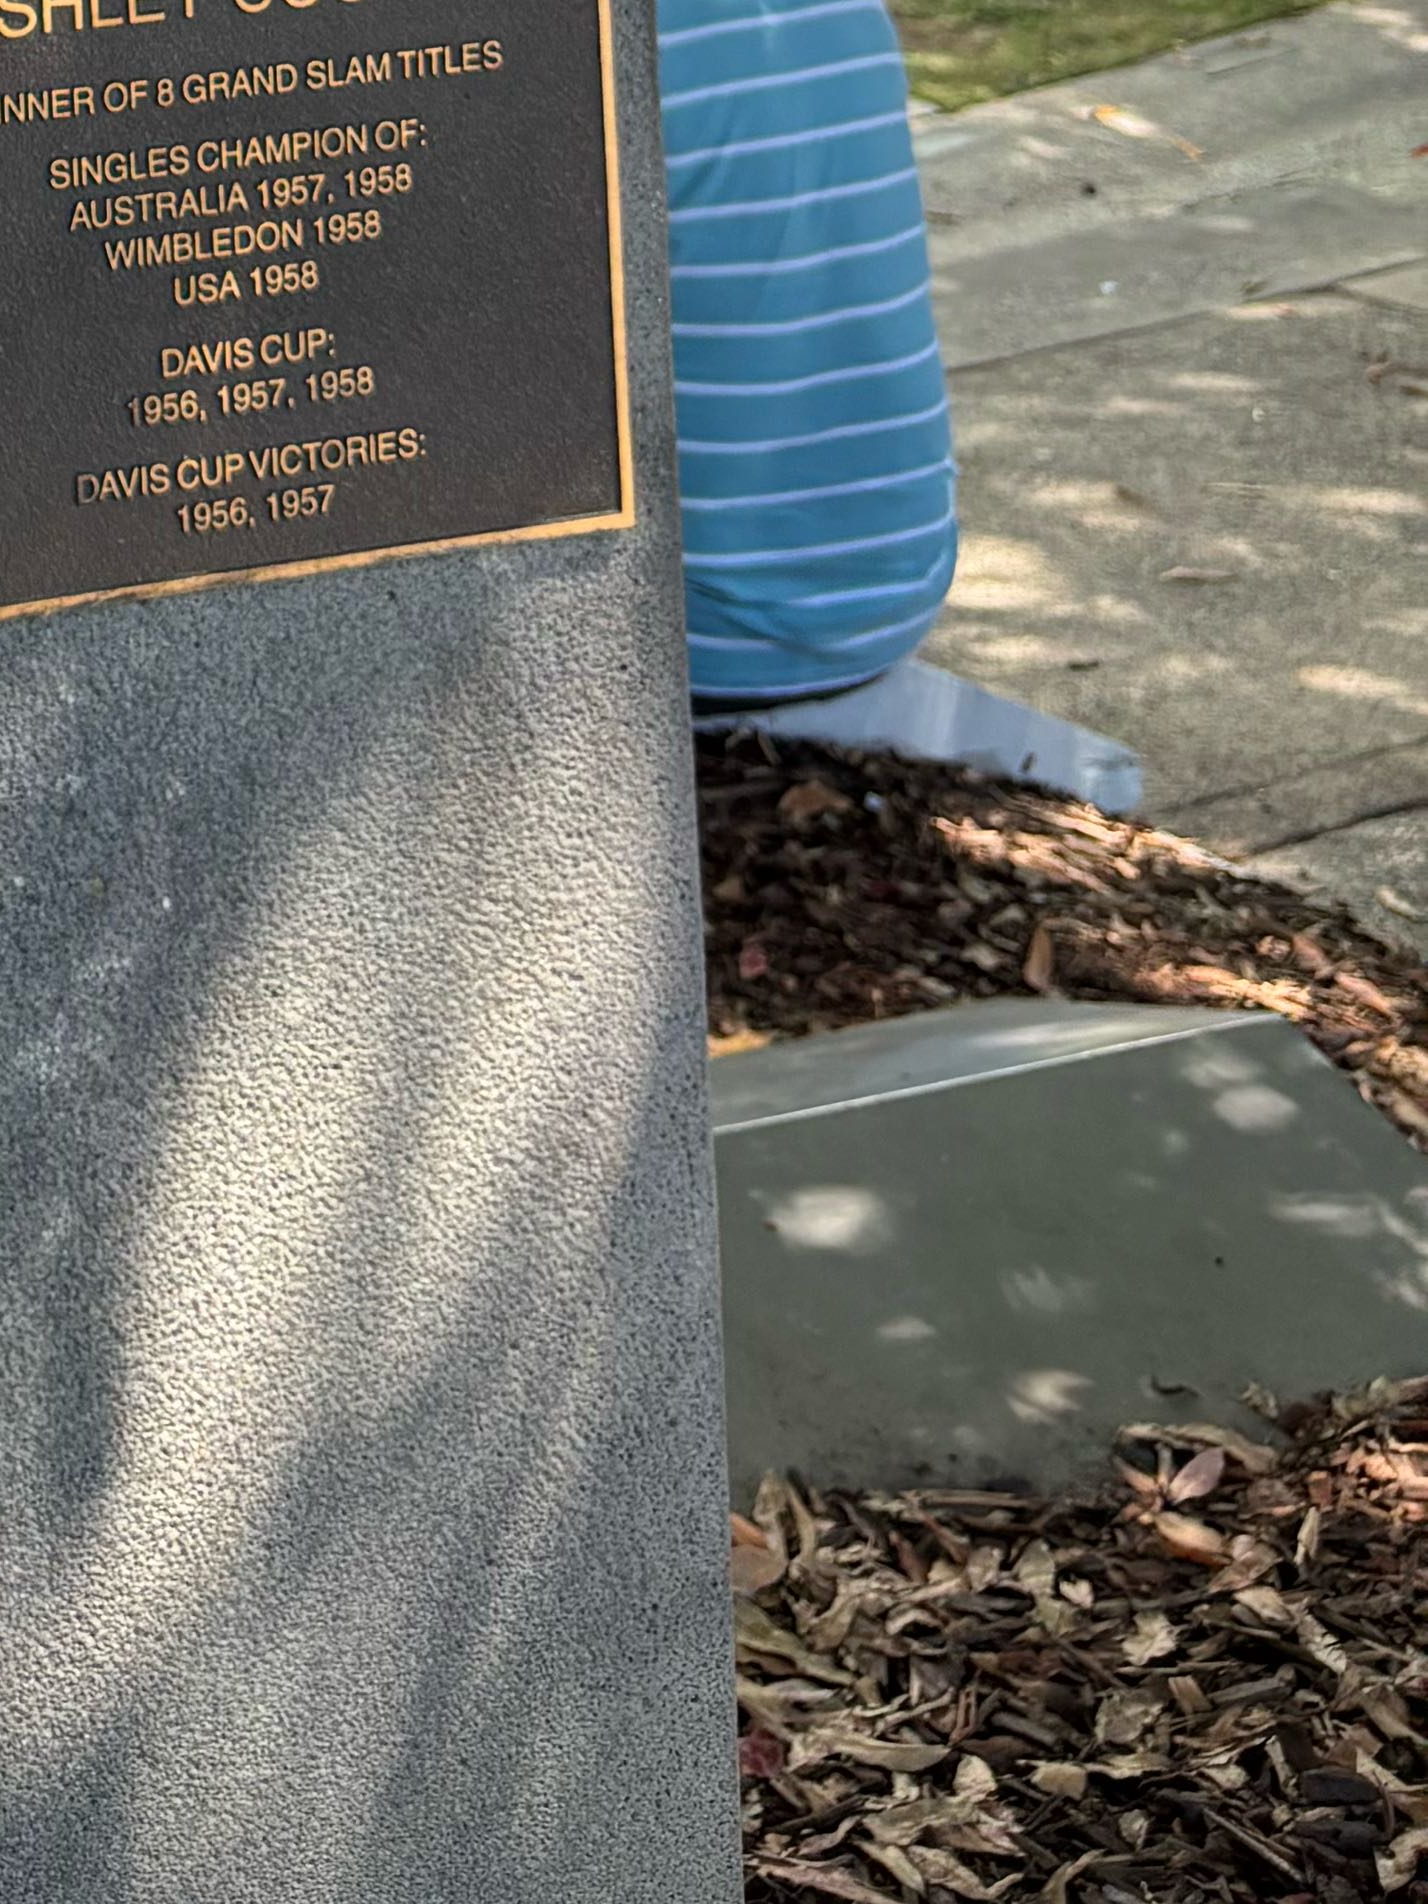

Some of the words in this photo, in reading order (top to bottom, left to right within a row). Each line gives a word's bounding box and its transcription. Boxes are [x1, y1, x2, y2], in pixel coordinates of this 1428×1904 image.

[102, 79, 147, 113] OF
[156, 79, 175, 109] 8
[182, 62, 298, 105] GRAND
[306, 52, 391, 90] SLAM
[397, 40, 503, 80] TITLES
[50, 144, 190, 191] SINGLES
[196, 126, 369, 175] CHAMPION
[374, 118, 428, 152] OF:
[69, 182, 249, 231] AUSTRALIA
[256, 173, 335, 211] 1957,
[345, 162, 413, 200] 1958
[105, 218, 304, 271] WIMBLEDON
[314, 209, 381, 245] 1958
[173, 270, 242, 307] USA
[250, 260, 318, 297] 1958
[160, 337, 255, 380] DAVIS
[259, 327, 336, 366] CUP:
[128, 389, 208, 426] 1956,
[218, 378, 295, 415] 1957,
[306, 365, 374, 402] 1958
[77, 463, 171, 505] DAVIS
[176, 452, 245, 491] CUP
[249, 427, 427, 480] VICTORIES:
[177, 495, 256, 533] 1956,
[266, 484, 334, 522] 1957
